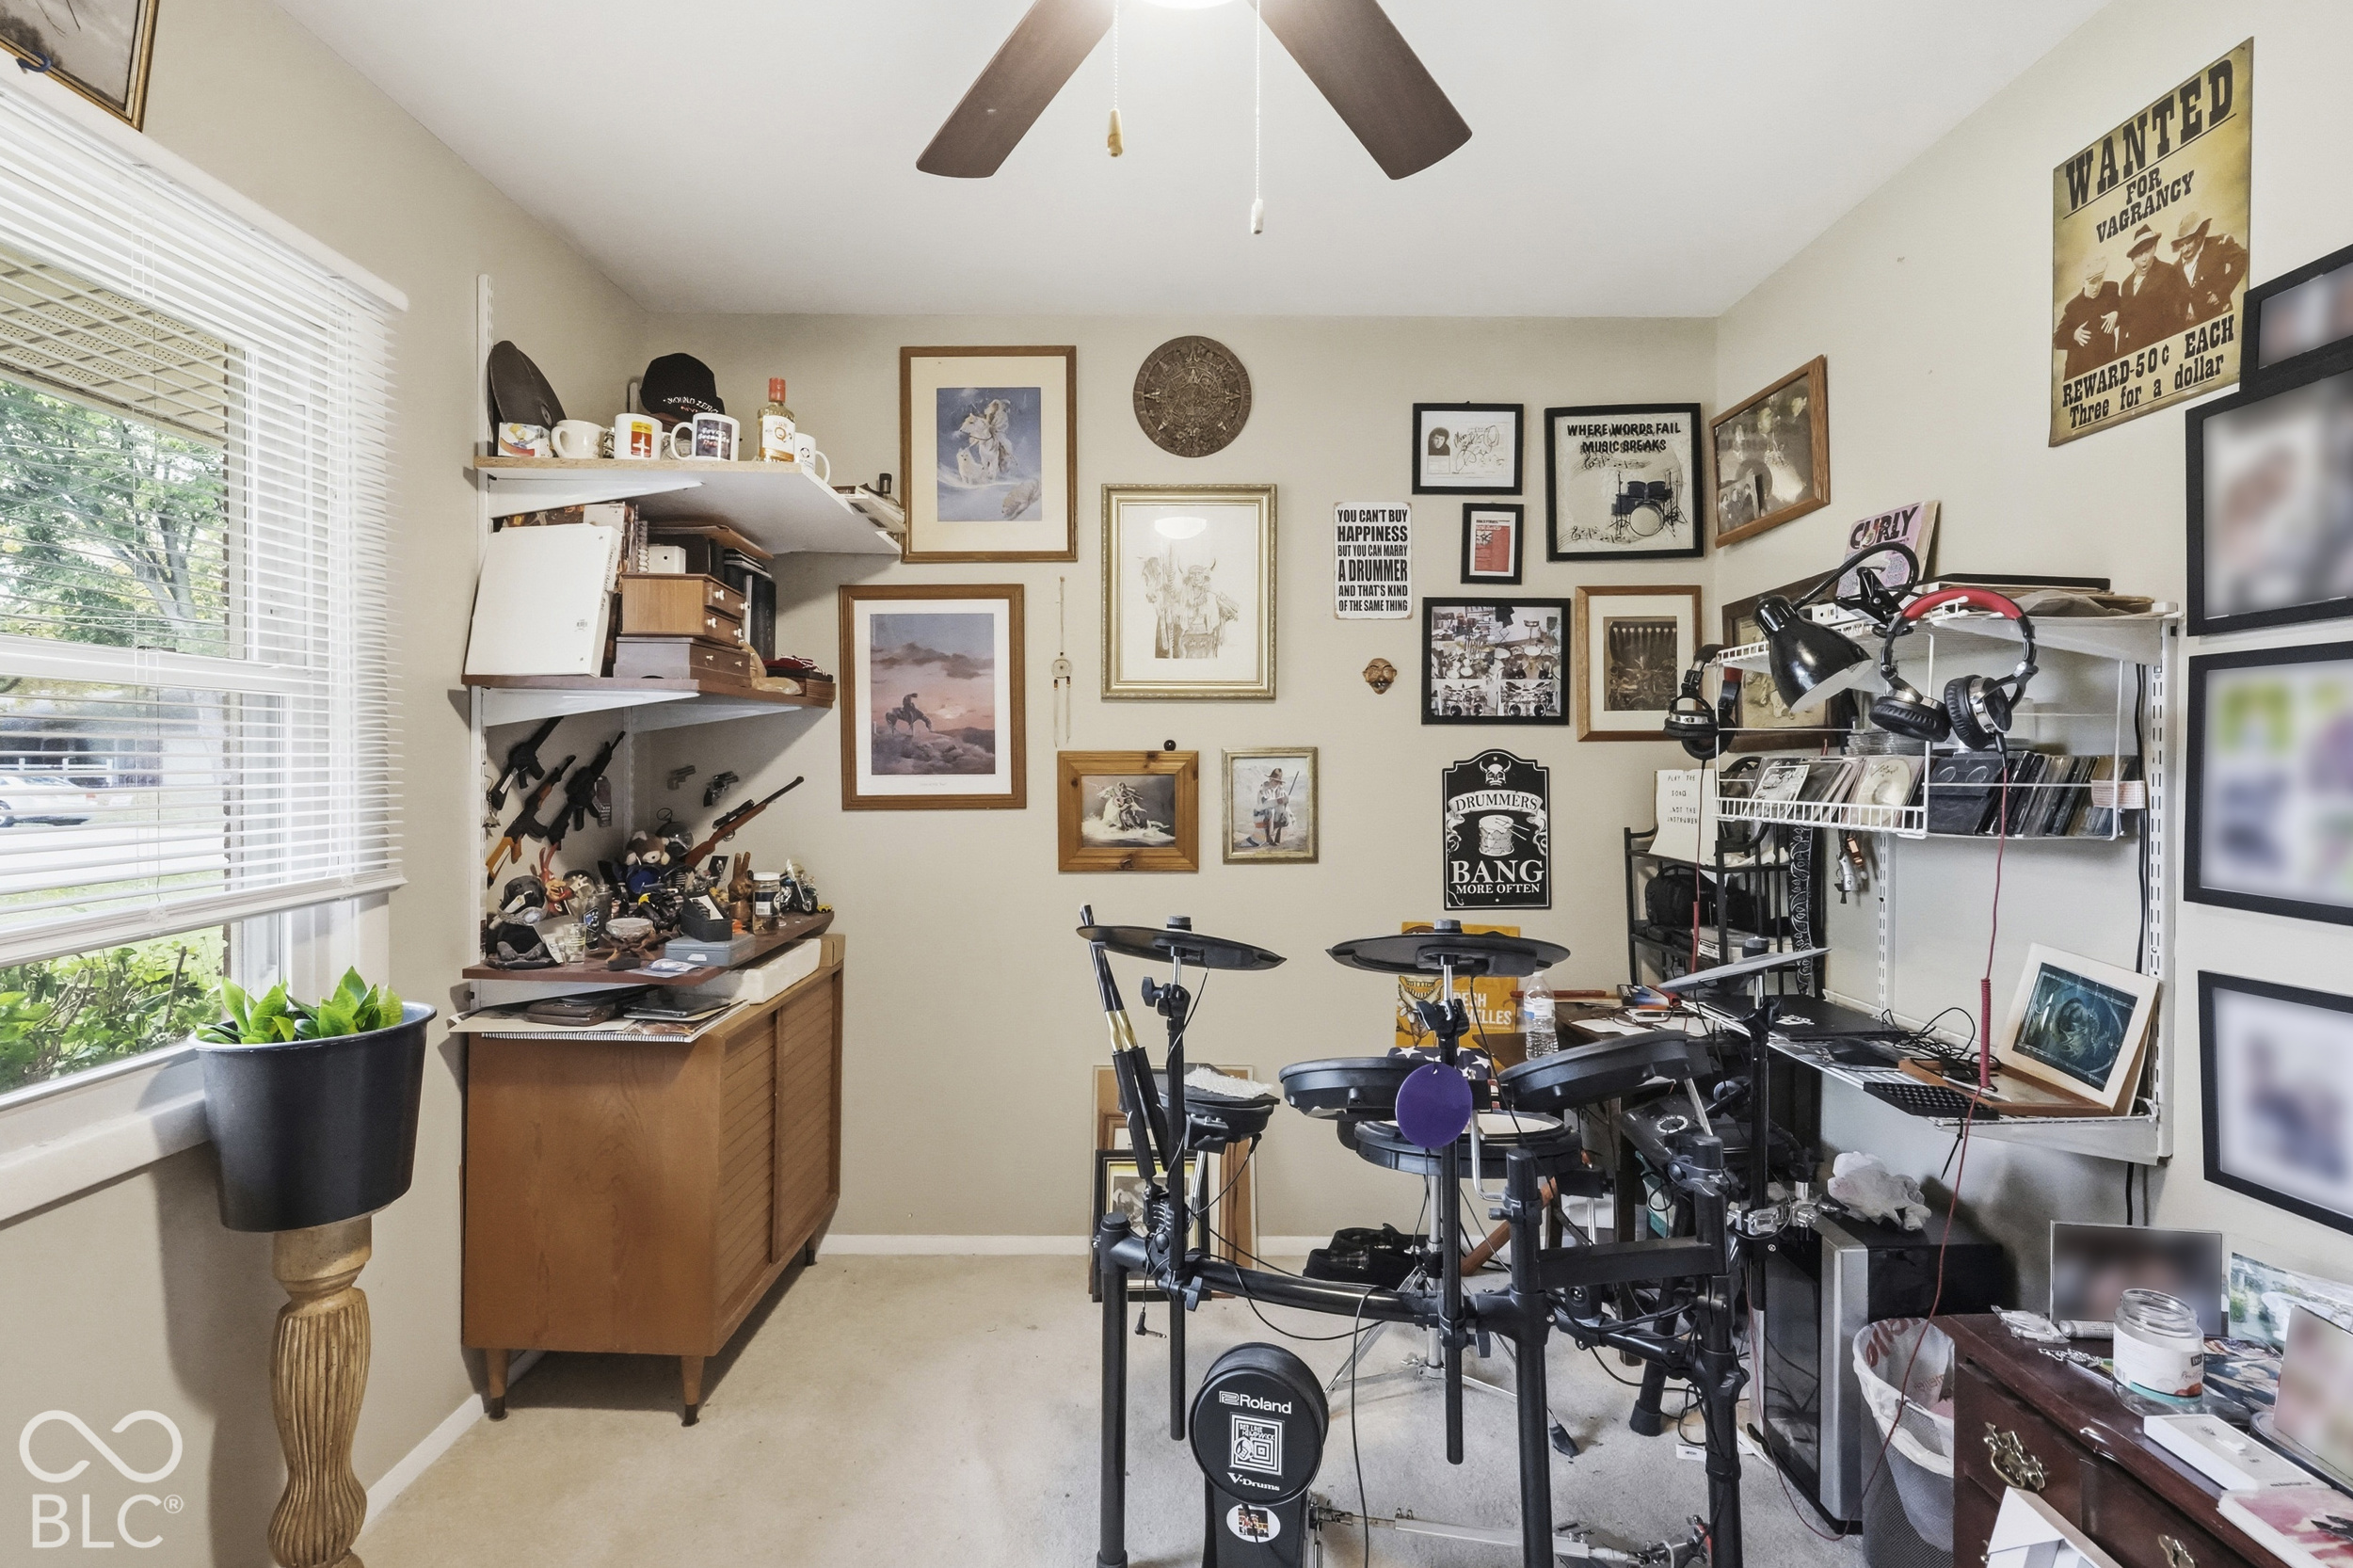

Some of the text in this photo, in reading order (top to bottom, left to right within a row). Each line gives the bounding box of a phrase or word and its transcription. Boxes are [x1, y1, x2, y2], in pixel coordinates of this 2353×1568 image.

[2066, 59, 2233, 212] WANTED
[2126, 168, 2162, 205] FOR
[2096, 169, 2195, 244] VAGRANCY
[2185, 314, 2234, 359] EACH
[2071, 354, 2224, 428] Three for a dollar
[1567, 422, 1681, 436] WHERE WORDS FAIL
[1582, 439, 1667, 454] MUSIC SPEAKS
[1337, 509, 1408, 522] YOU CAN'T BUY
[1337, 525, 1408, 542] HAPPINESS
[1337, 544, 1408, 556] BUT YOU CAN MARRY
[1337, 559, 1408, 582] A DRUMMER
[1338, 584, 1408, 597] AND THAT'S KIND
[1338, 600, 1408, 612] OF THE SAME THING
[1455, 792, 1538, 811] DRUMMERS
[1450, 859, 1545, 884] BANG
[1456, 883, 1541, 894] MORE OFTEN
[1452, 991, 1487, 1007] RESH
[1240, 1393, 1292, 1415] Roland
